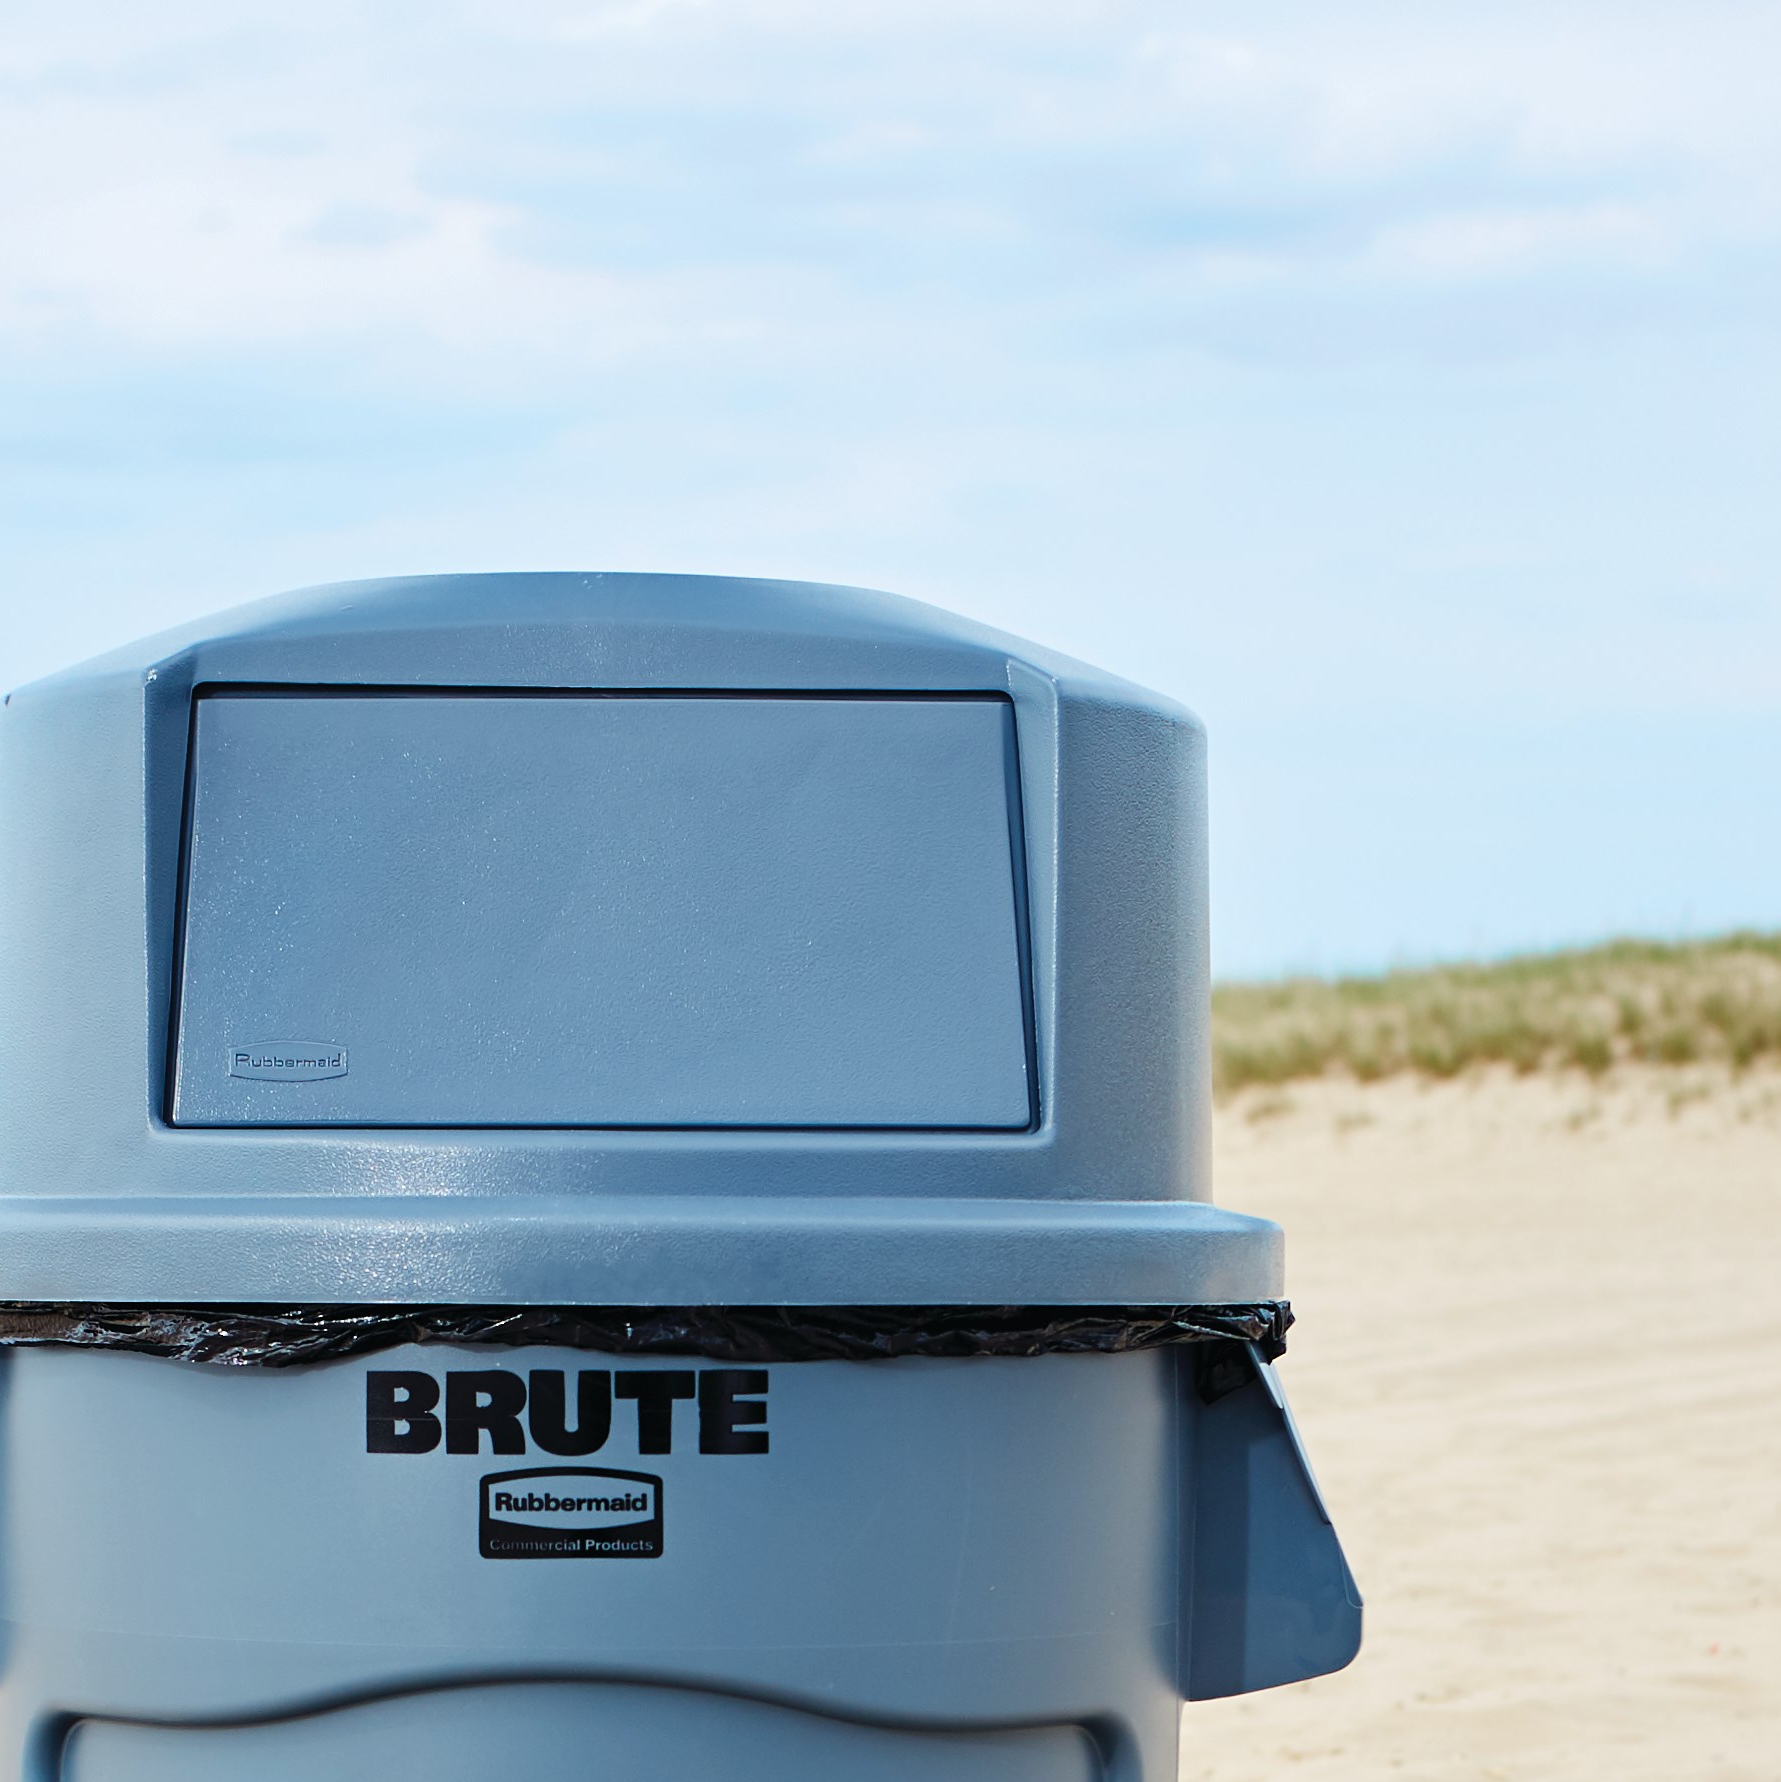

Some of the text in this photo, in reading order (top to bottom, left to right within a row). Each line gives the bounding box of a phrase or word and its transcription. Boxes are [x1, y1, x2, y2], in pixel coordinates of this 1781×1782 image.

[234, 1053, 341, 1068] Rubbermaid
[366, 1369, 770, 1457] BRUTE
[494, 1492, 648, 1512] Rubbermaid
[489, 1538, 654, 1552] Commercial Products
